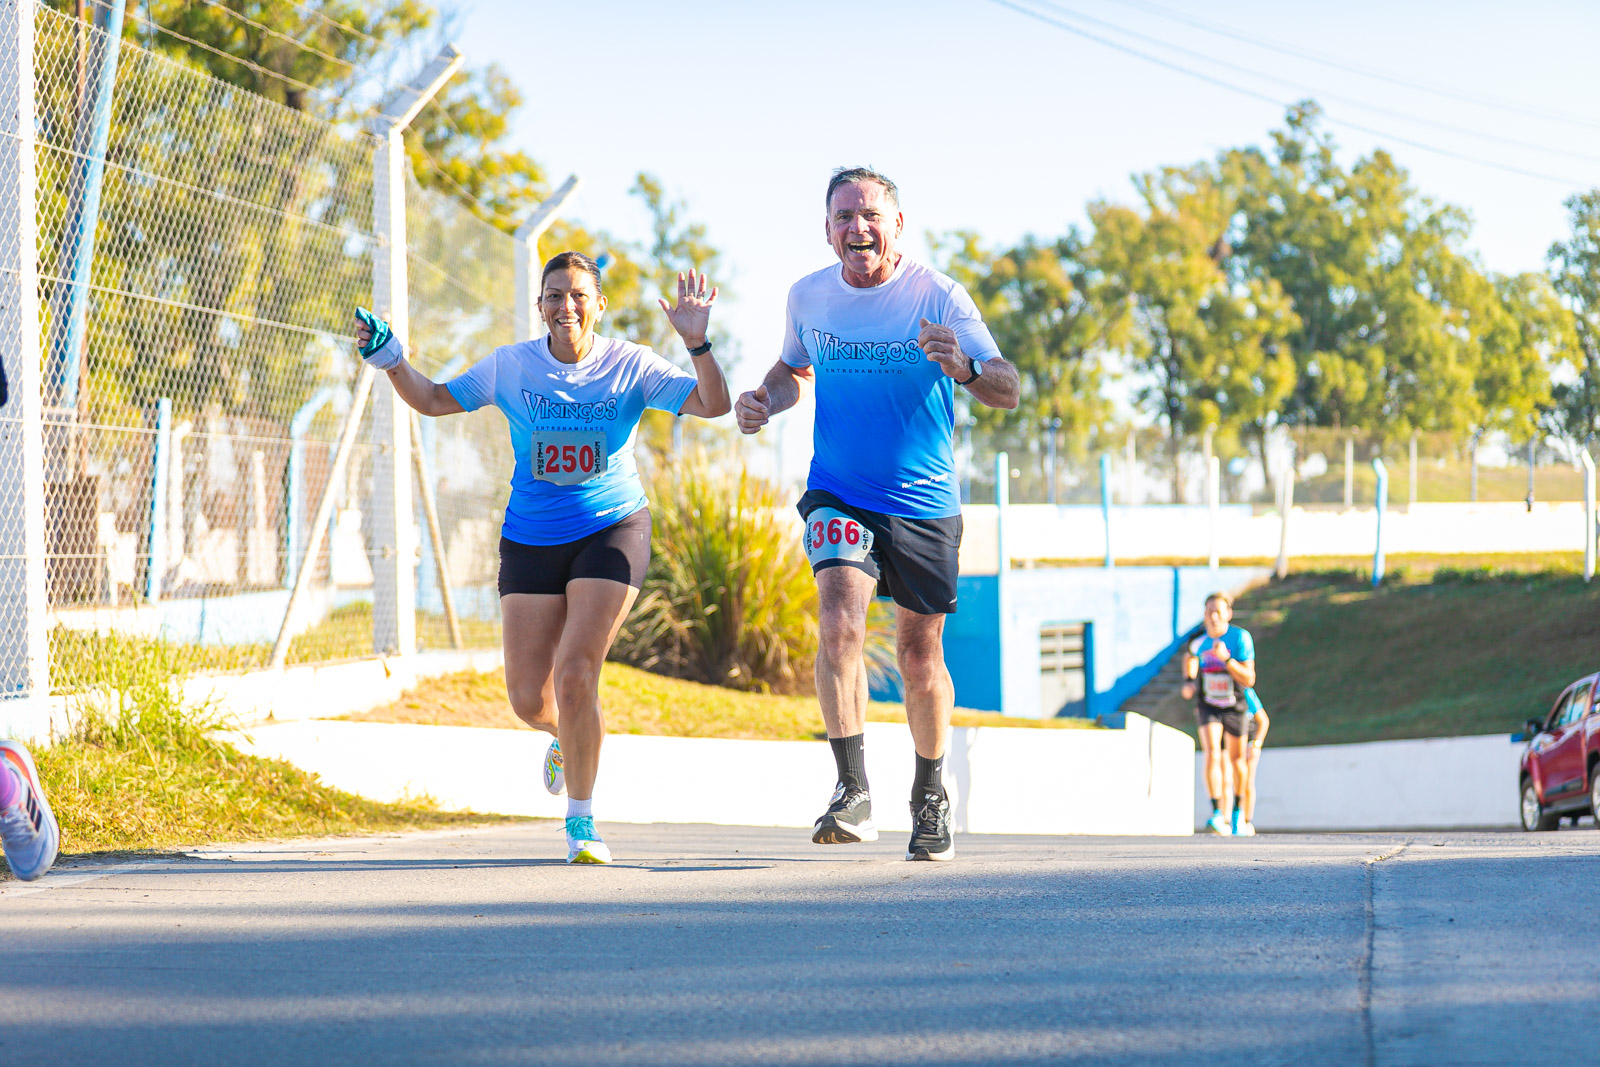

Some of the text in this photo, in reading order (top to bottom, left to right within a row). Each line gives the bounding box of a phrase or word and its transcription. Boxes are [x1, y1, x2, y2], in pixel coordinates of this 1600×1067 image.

[825, 367, 903, 375] ENTRENAMIENTO
[537, 441, 545, 475] TIEMPO
[545, 444, 594, 473] 250
[812, 518, 860, 549] 366
